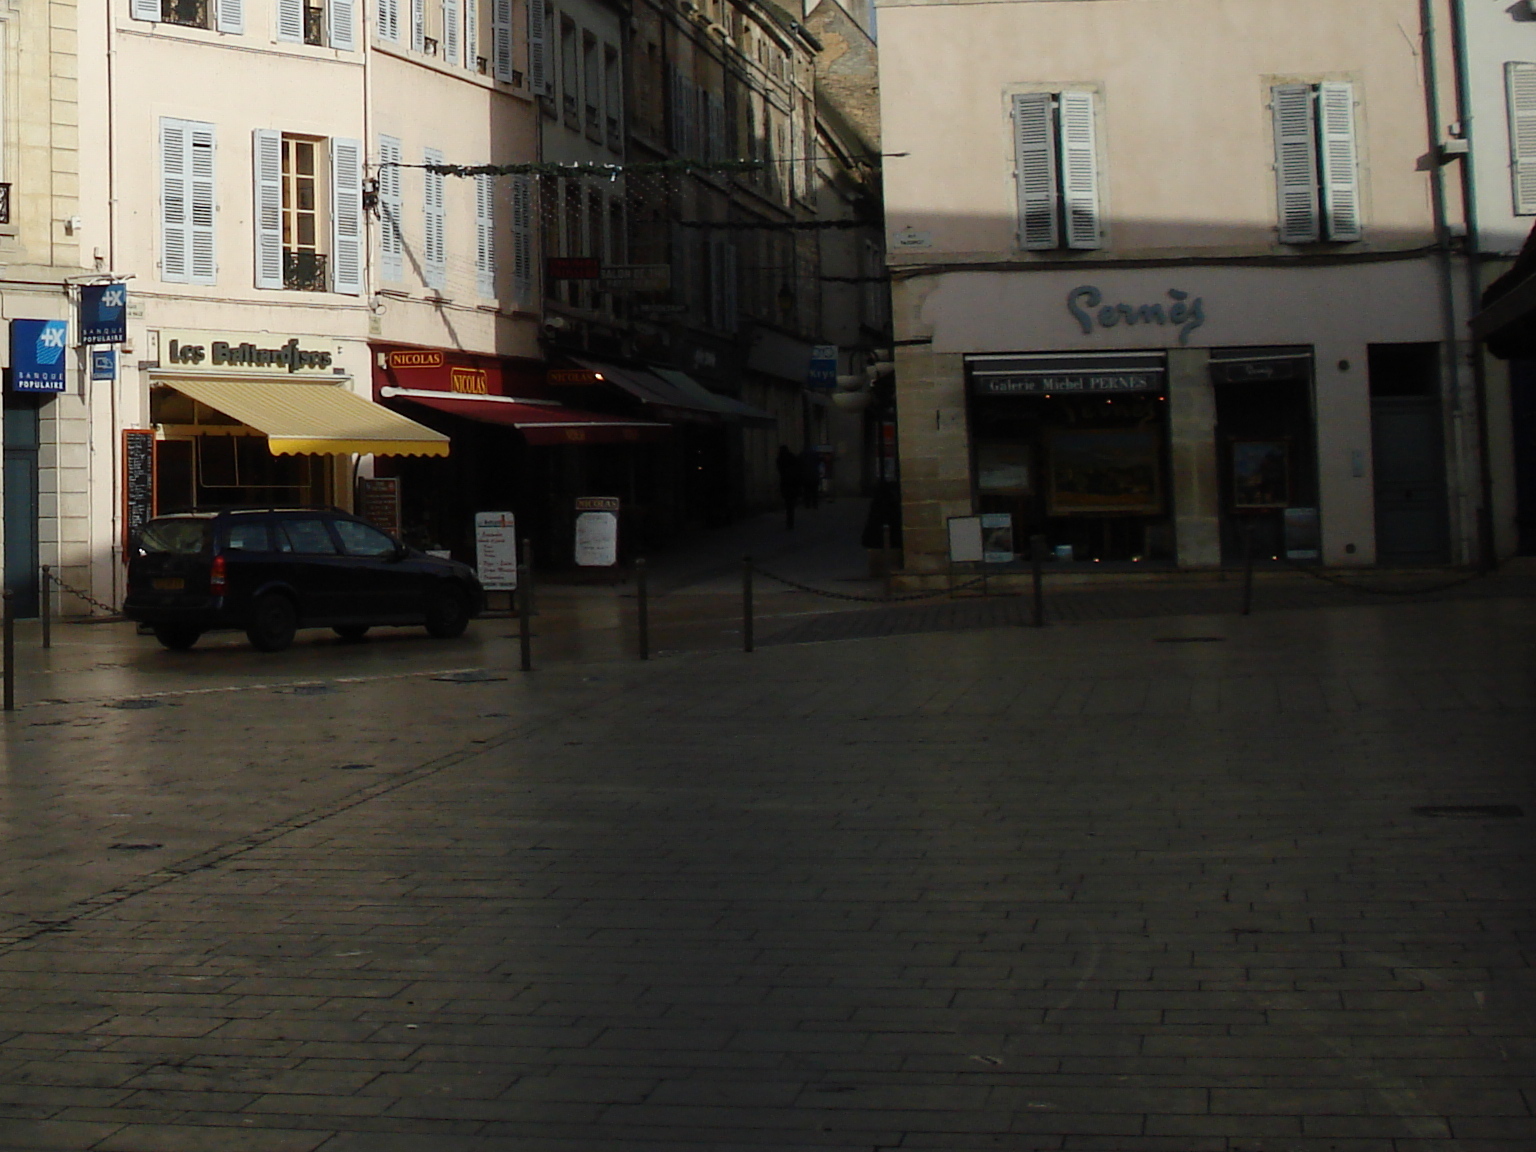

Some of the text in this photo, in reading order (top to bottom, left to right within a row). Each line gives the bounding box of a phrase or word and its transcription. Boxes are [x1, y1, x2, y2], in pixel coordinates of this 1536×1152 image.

[169, 339, 205, 365] Les
[393, 354, 440, 364] NICOLAS
[19, 372, 64, 381] BANQUE
[19, 381, 64, 390] POPULAIRE
[452, 375, 486, 395] NICOLAS
[989, 378, 1035, 391] Galerie
[1043, 377, 1083, 390] Michel
[578, 499, 616, 508] NICOLAS
